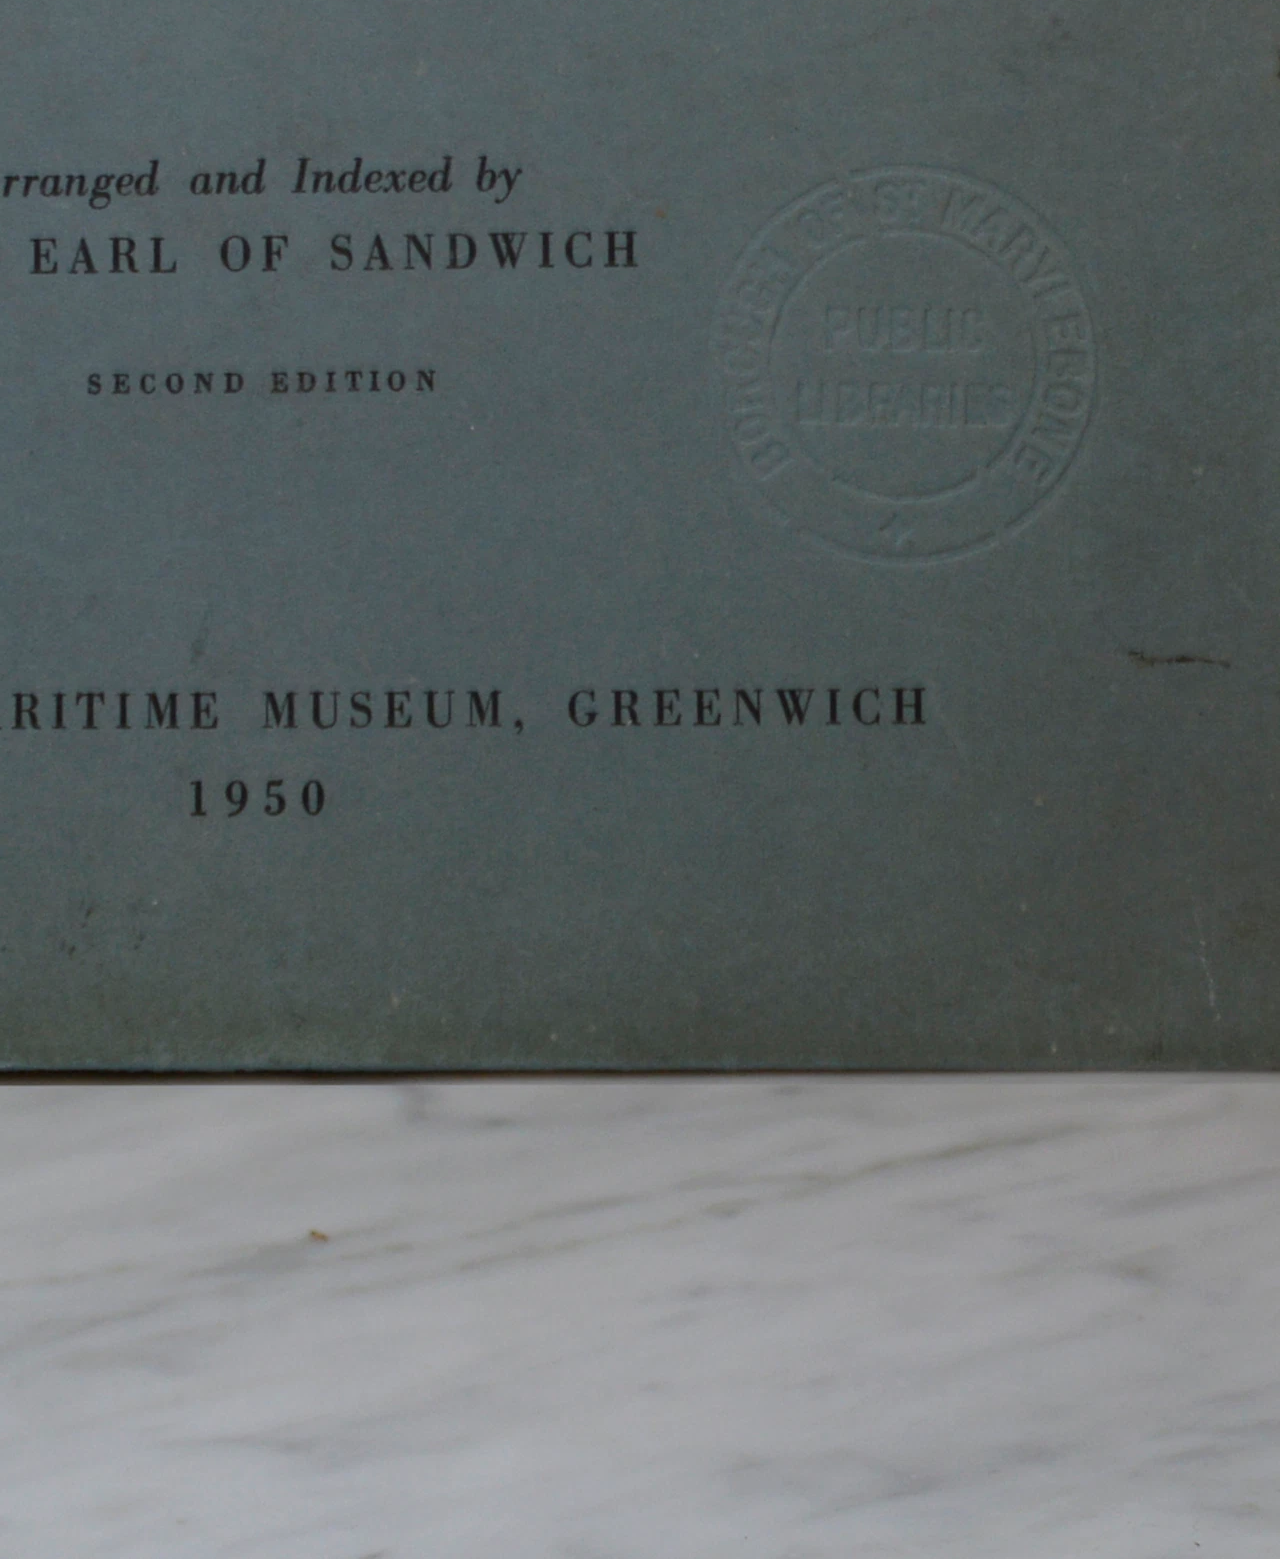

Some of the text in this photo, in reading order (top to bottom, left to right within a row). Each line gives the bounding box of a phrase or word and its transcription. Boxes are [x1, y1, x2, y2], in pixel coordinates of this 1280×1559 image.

[190, 159, 266, 198] and
[292, 156, 453, 195] Indexed
[477, 155, 522, 202] by
[29, 237, 178, 275] EARL
[220, 234, 289, 273] OF
[330, 230, 639, 271] SANDWICH
[823, 305, 987, 353] PUBLIC
[86, 369, 437, 396] SECOND EDITION
[262, 689, 525, 734] MUSEUM,
[568, 686, 927, 728] GREENWICH
[189, 779, 325, 818] 1950
